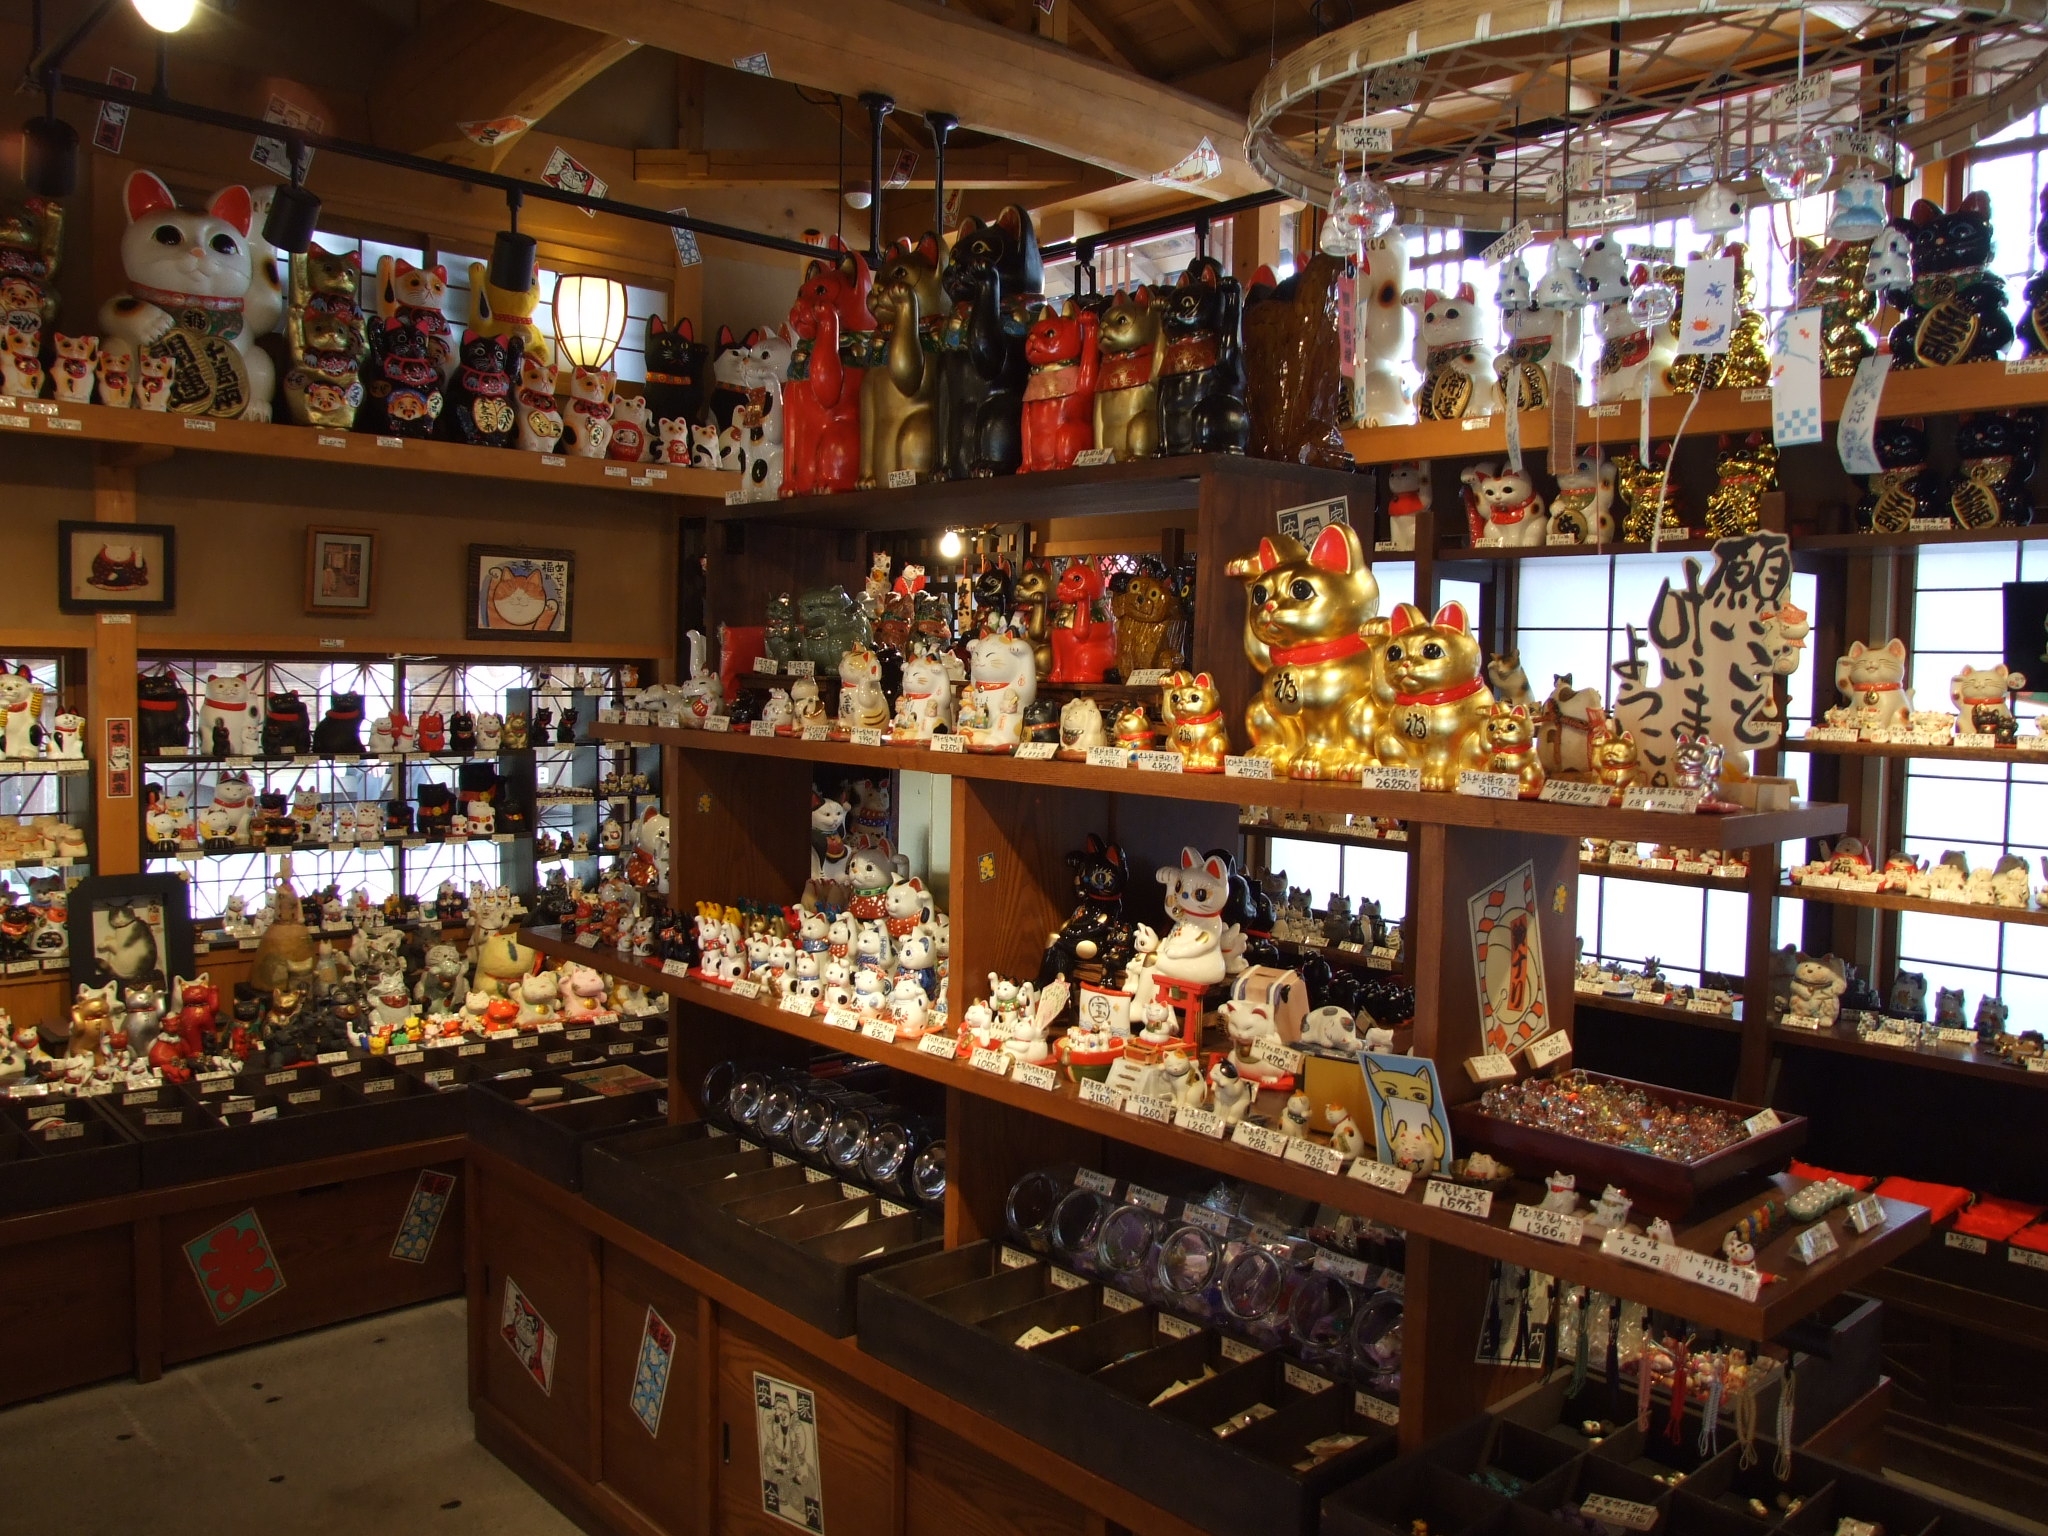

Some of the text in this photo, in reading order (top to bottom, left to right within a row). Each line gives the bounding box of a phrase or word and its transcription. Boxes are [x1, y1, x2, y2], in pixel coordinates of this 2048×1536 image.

[1273, 672, 1298, 703] 福
[1405, 712, 1427, 739] 福
[1620, 1245, 1661, 1266] 420円
[1695, 1270, 1740, 1293] 420円
